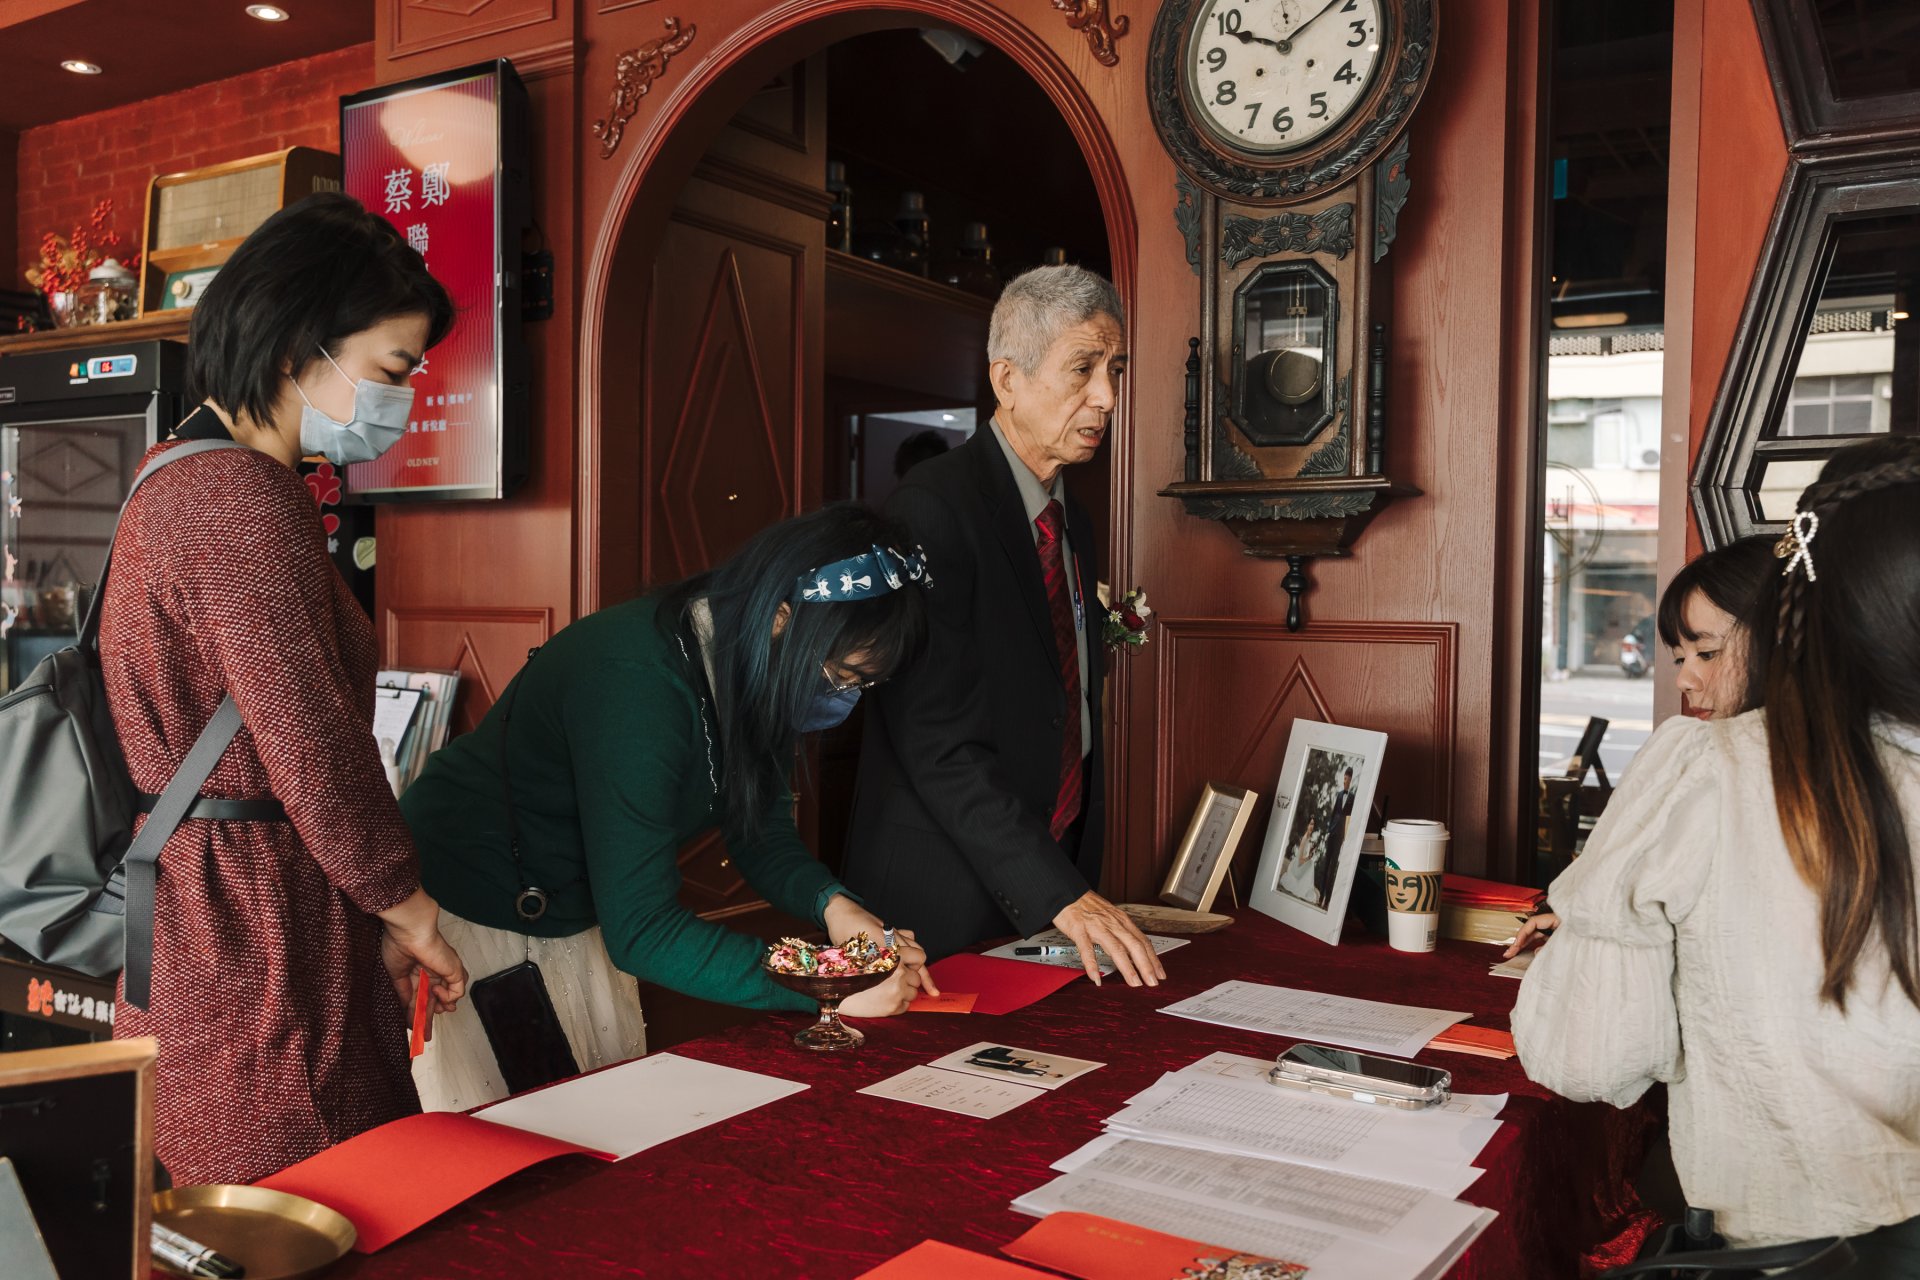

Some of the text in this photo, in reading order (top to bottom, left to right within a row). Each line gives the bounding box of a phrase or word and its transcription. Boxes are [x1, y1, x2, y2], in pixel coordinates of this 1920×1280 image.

[1217, 8, 1242, 36] 10
[1346, 19, 1367, 47] 3
[1206, 47, 1227, 73] 9
[1333, 59, 1357, 85] 4
[1215, 80, 1237, 106] 8
[1307, 91, 1328, 118] 5
[1243, 102, 1263, 129] 7
[1272, 106, 1294, 132] 6
